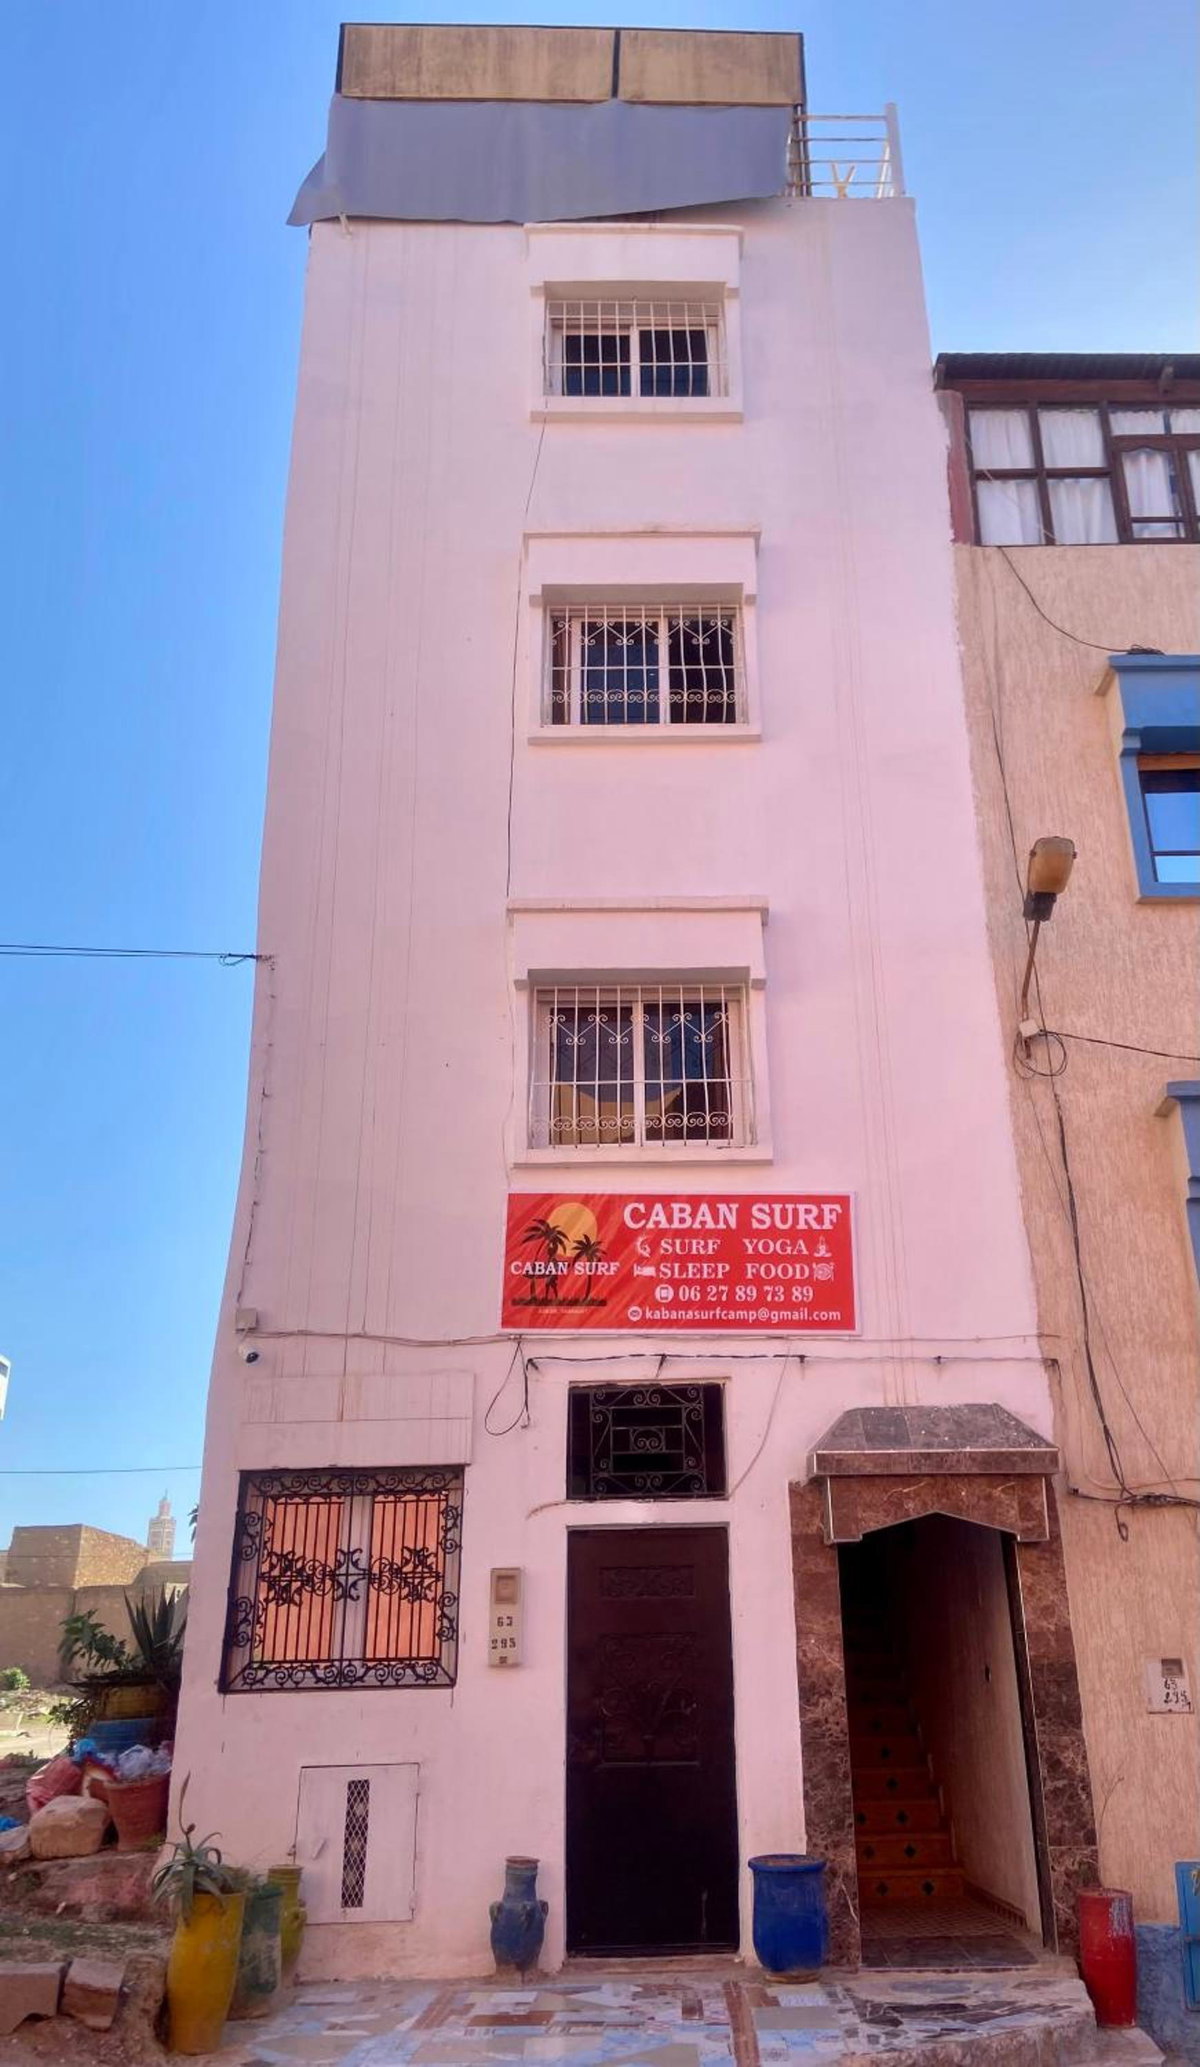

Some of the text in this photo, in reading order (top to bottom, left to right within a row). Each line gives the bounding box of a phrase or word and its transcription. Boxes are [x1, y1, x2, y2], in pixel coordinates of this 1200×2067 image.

[623, 1202, 842, 1230] CABAN SURF
[660, 1238, 721, 1255] SURF
[742, 1238, 809, 1255] YOGA
[510, 1261, 620, 1276] CABAN SURF
[659, 1263, 730, 1280] SLEEP
[745, 1263, 809, 1280] FOOD
[679, 1285, 814, 1302] 06 27 89 73 89
[645, 1307, 841, 1324] kabanasurfcamp@gmail.com
